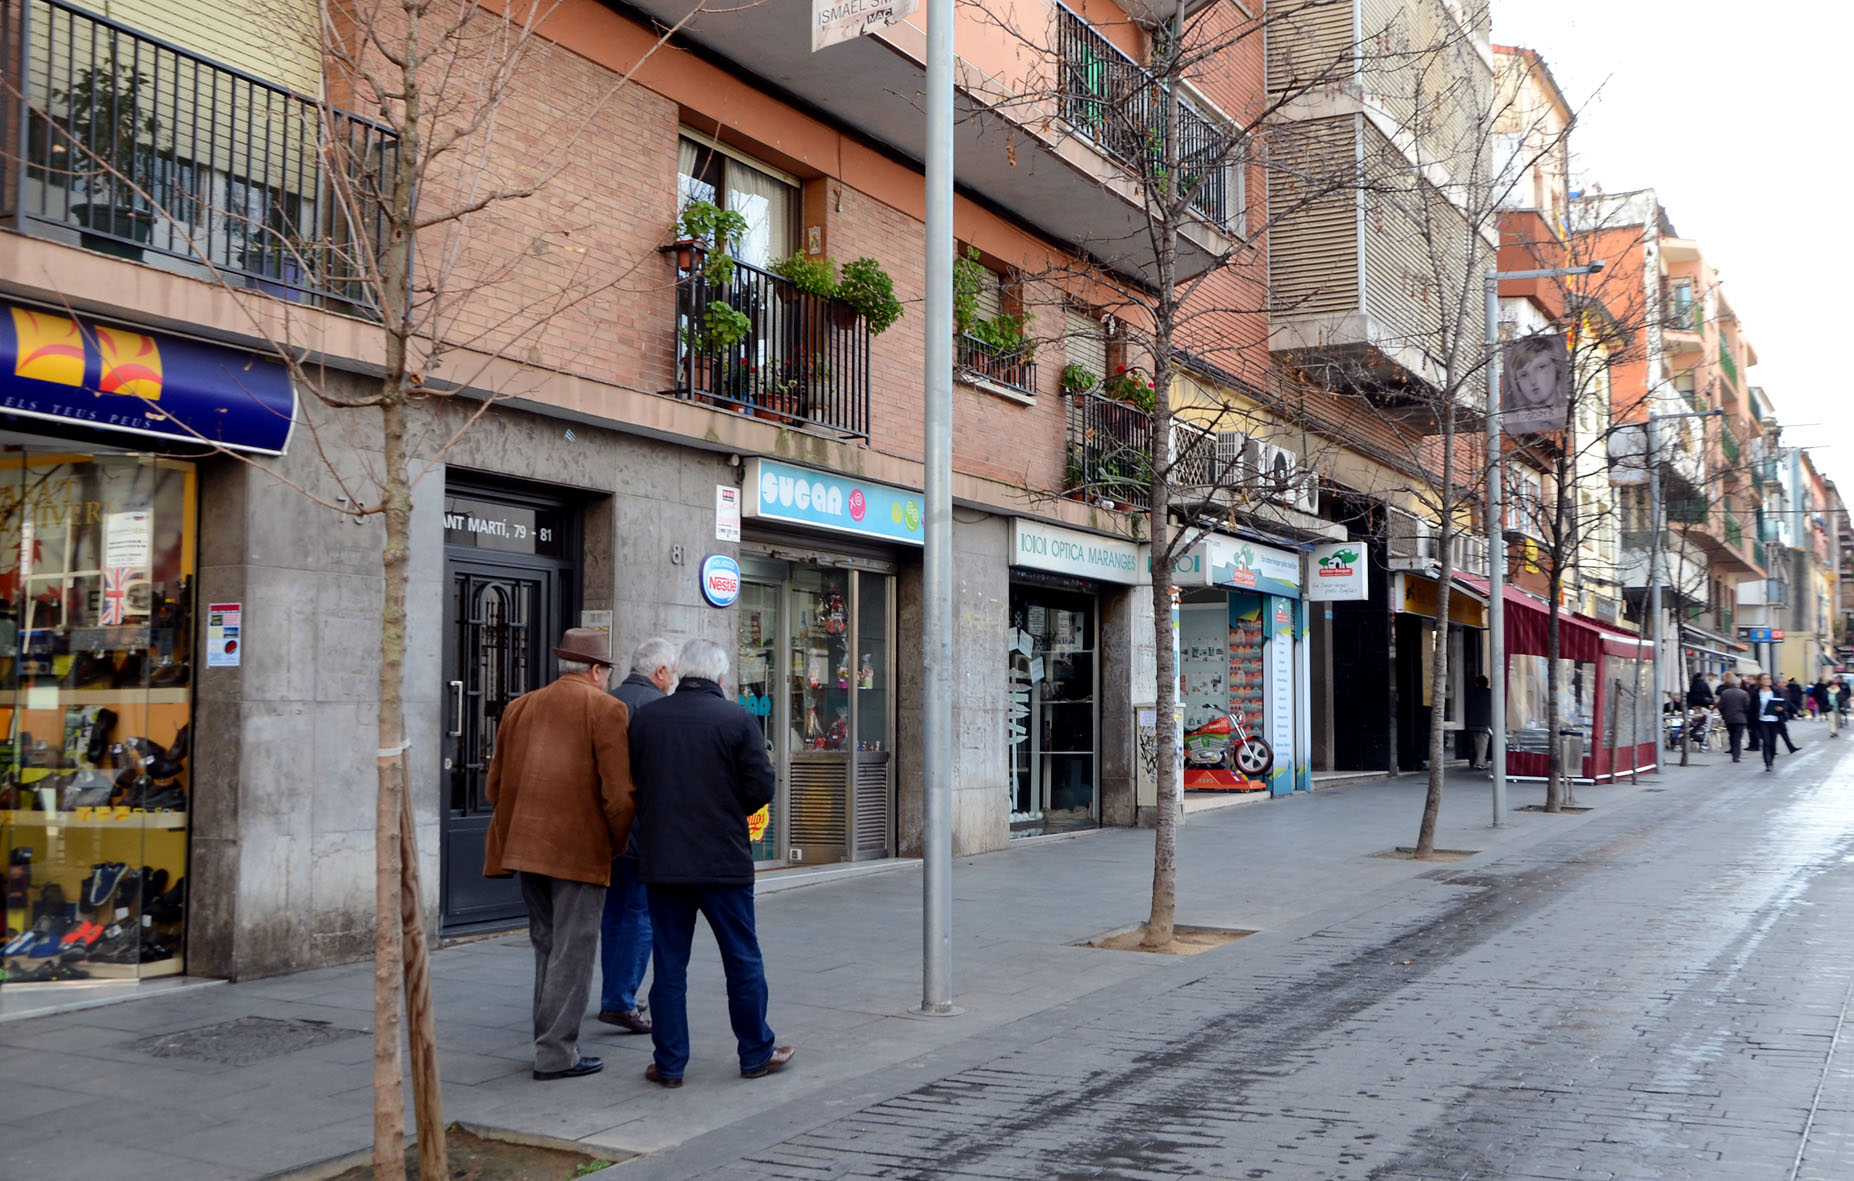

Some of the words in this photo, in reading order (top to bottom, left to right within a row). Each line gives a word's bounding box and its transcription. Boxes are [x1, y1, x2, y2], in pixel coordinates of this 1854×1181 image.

[818, 0, 867, 25] ISMAEL
[4, 397, 38, 410] ELS
[52, 404, 97, 420] TEUS
[109, 414, 152, 429] PEUS
[761, 472, 843, 516] SUGAR
[467, 517, 510, 539] MARTÍ,
[514, 524, 526, 539] 79
[540, 528, 552, 542] 81
[670, 544, 686, 566] 81
[1051, 540, 1085, 562] OPTICA
[1088, 547, 1137, 572] MARANGES
